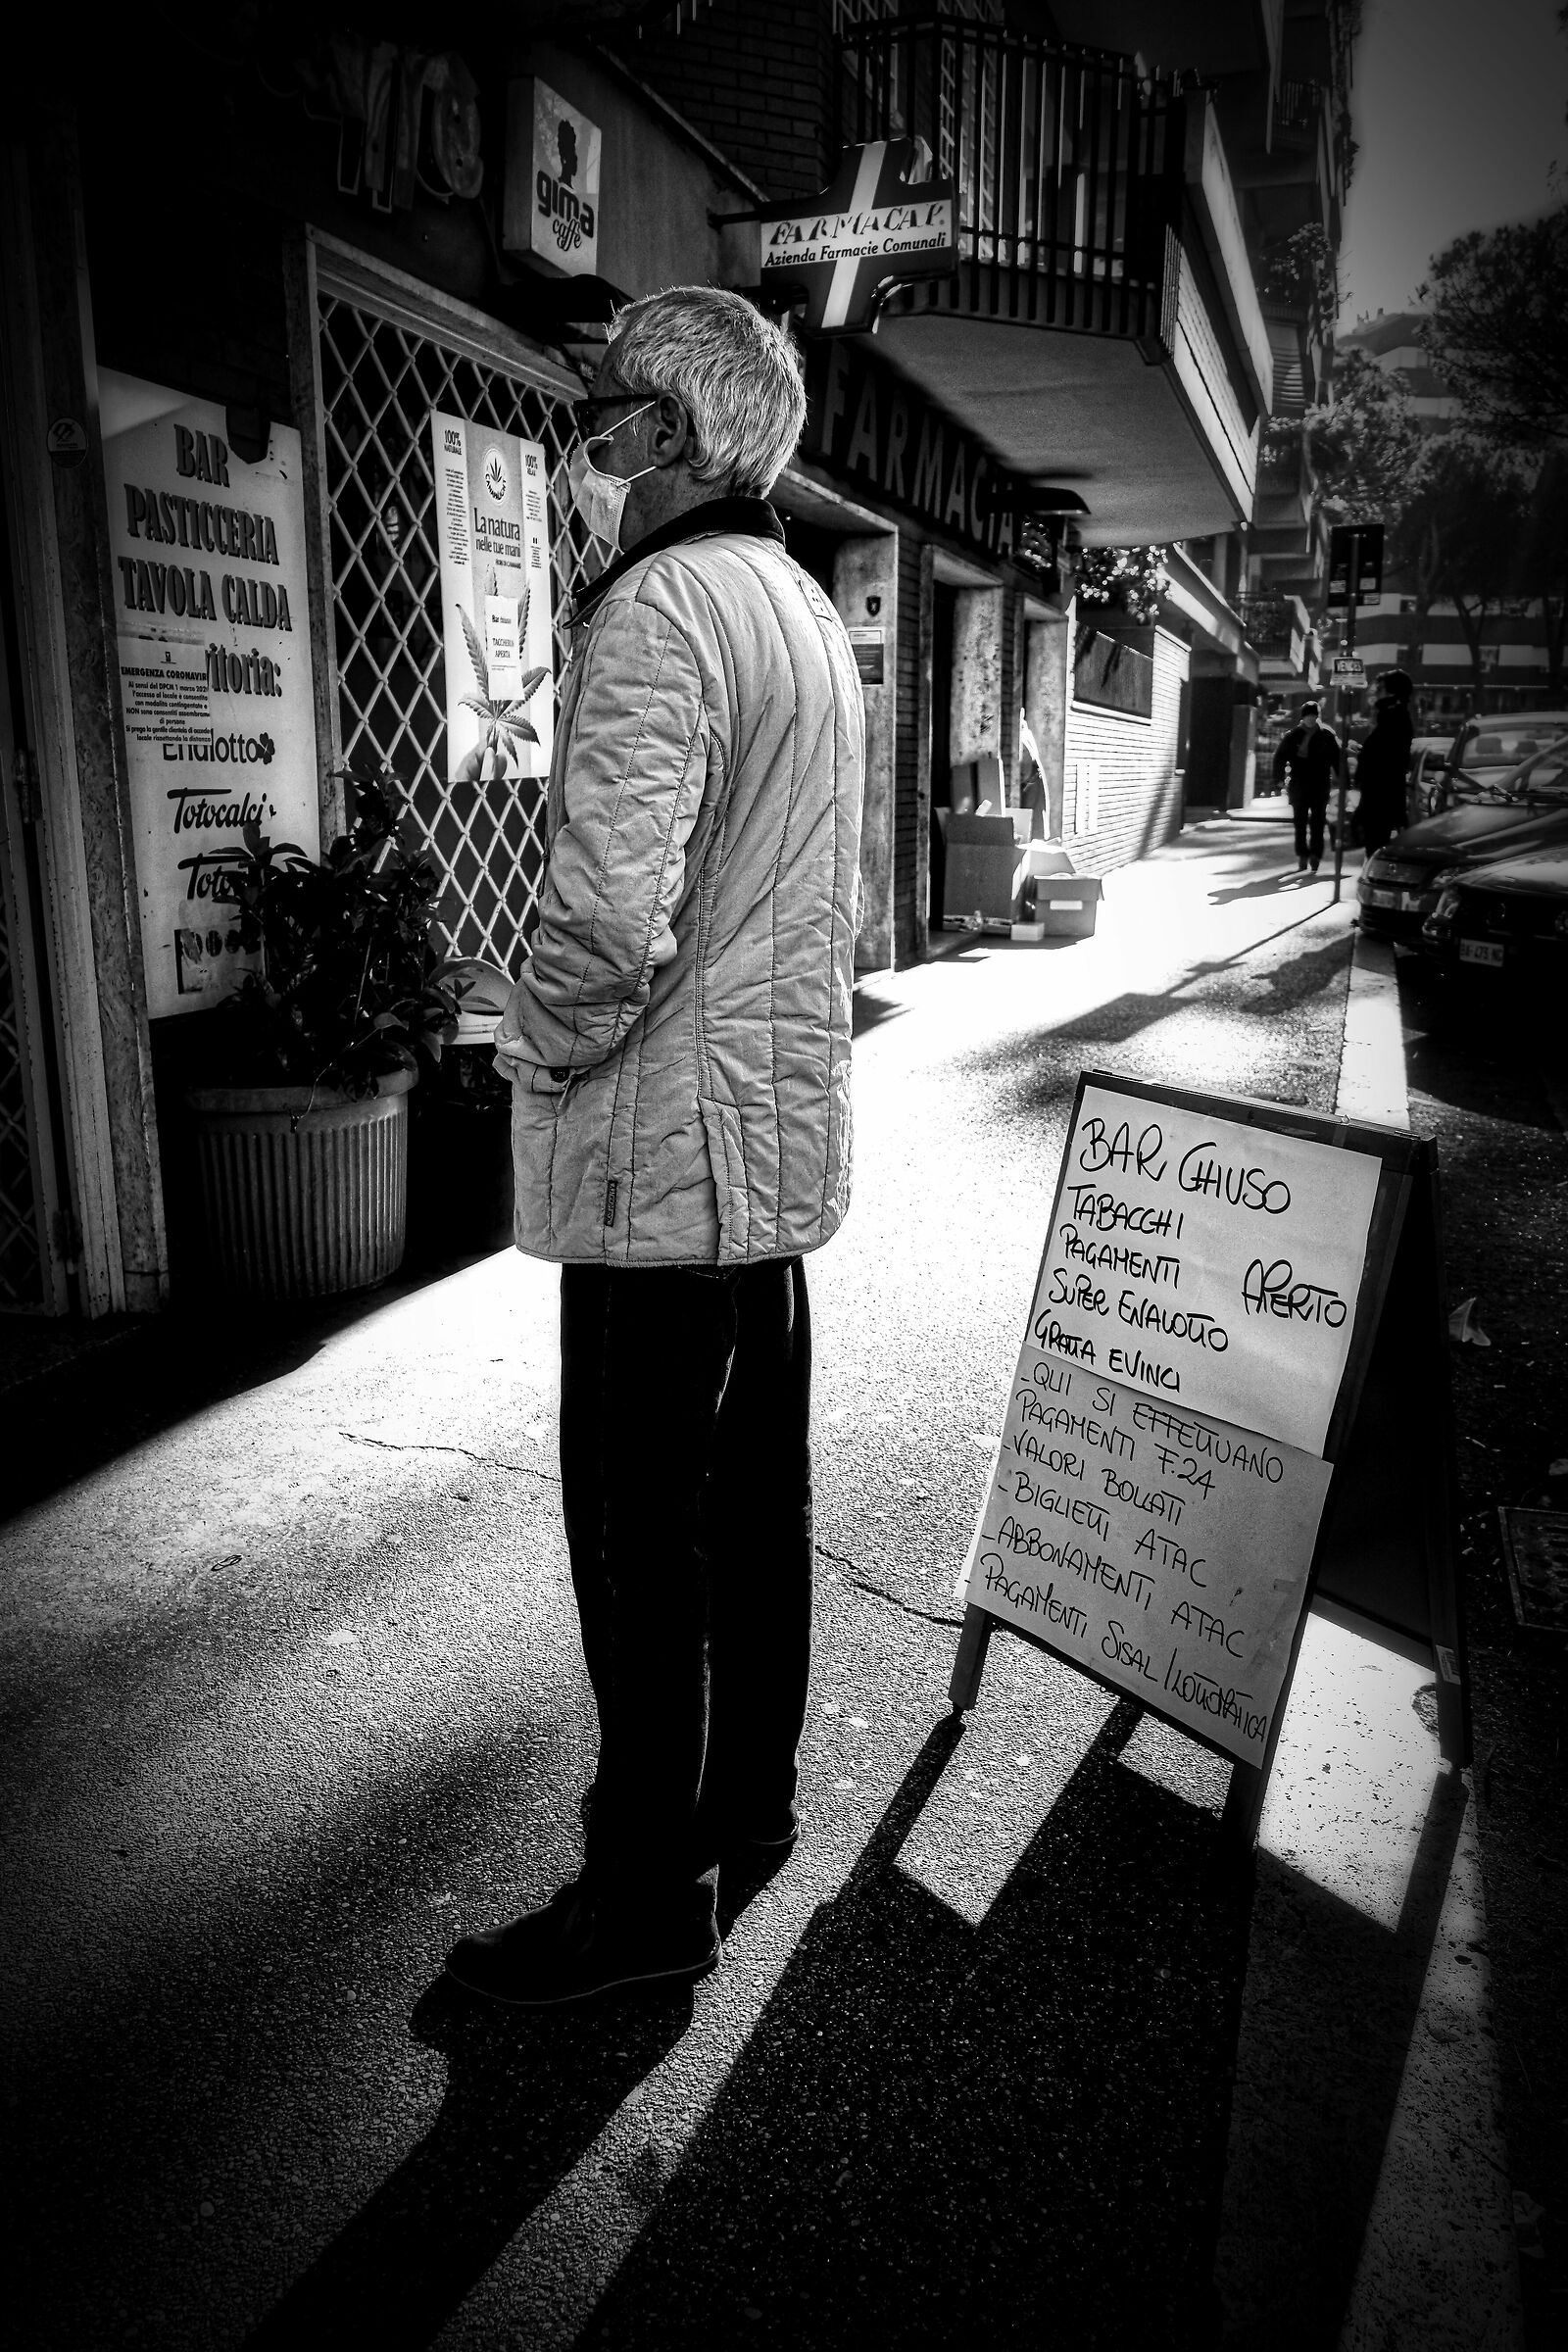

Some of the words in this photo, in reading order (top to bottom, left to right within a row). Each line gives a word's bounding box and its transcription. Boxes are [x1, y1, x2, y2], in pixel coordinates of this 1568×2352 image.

[536, 170, 594, 239] gima
[764, 248, 815, 267] Azienda
[819, 241, 878, 261] Farmacie
[882, 231, 946, 253] Comunali
[173, 423, 230, 488] BAR
[820, 338, 1013, 560] FARMACIA
[123, 482, 279, 565] PASTICCERIA
[473, 507, 487, 534] La
[488, 517, 520, 541] natura
[475, 537, 492, 551] nelle
[505, 544, 521, 558] mani
[118, 556, 217, 620] TAVOLA
[221, 574, 292, 631] CALDA
[121, 666, 165, 678] EMERGENZA
[168, 787, 276, 834] Totocalci
[1079, 1118, 1168, 1182] BAR
[1178, 1142, 1292, 1214] CHIUSO
[1067, 1184, 1184, 1240] TABACCHI
[1059, 1223, 1181, 1290] PAGAMENTI
[1118, 1290, 1229, 1352] ENALOTTO
[1241, 1259, 1348, 1328] APERTO
[1034, 1309, 1097, 1366] GRATTA
[1015, 1388, 1135, 1462] PAGAMENTI
[1092, 1387, 1116, 1417] SI
[1132, 1401, 1284, 1484] EFFETTUANO
[1101, 1468, 1186, 1527] BOLLATI
[1133, 1528, 1206, 1589] ATAC
[980, 1552, 1089, 1638] PAGAMENTI
[1170, 1600, 1245, 1658] ATAC
